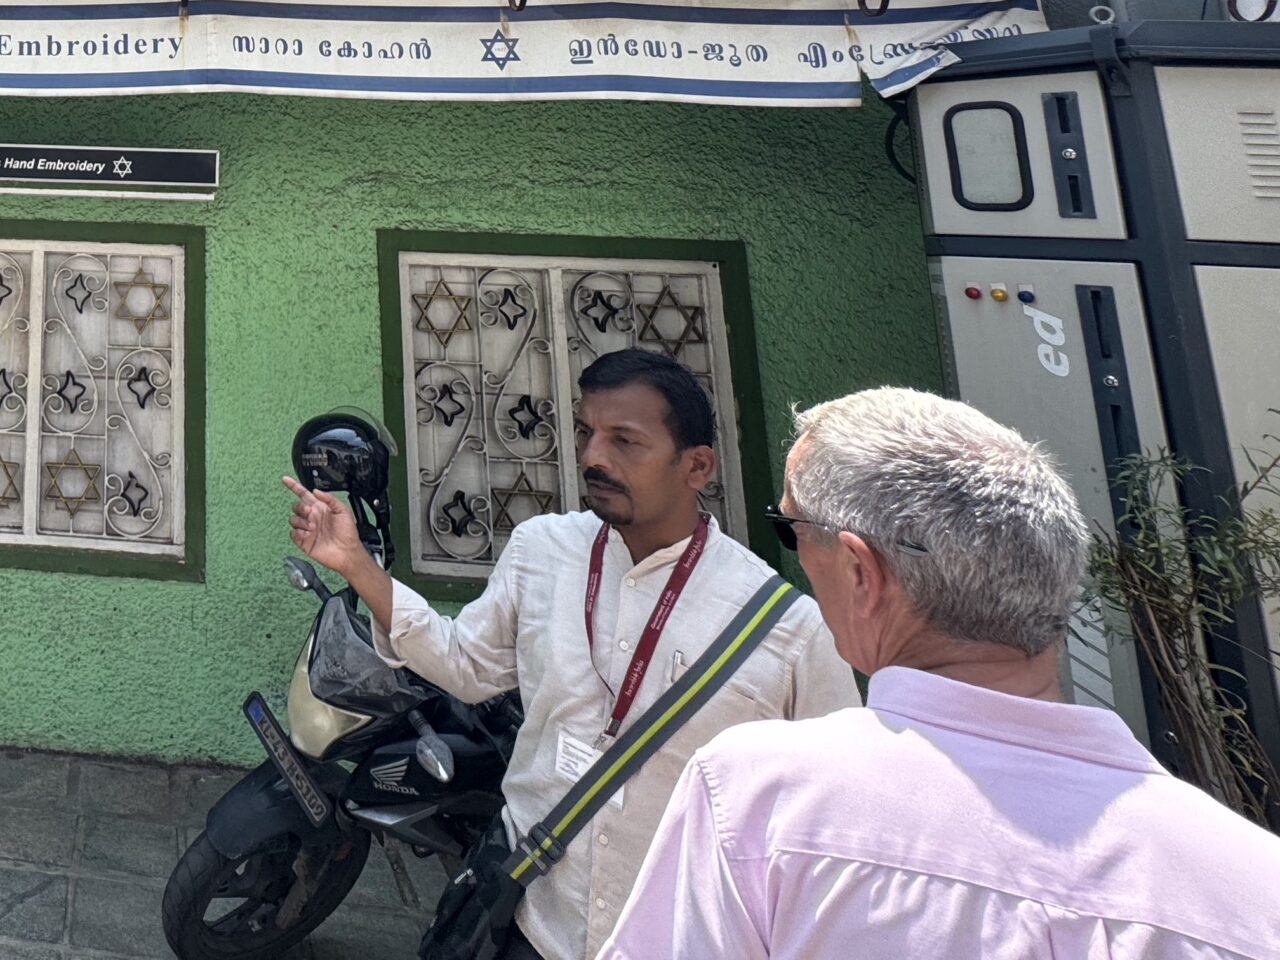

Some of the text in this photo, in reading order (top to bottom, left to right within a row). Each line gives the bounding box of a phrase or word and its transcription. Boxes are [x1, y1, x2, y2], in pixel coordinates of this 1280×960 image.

[232, 35, 432, 60] സാറാ കോഹൻ
[4, 157, 35, 169] Hand
[37, 159, 106, 174] Embroidery
[374, 781, 420, 796] HONDA
